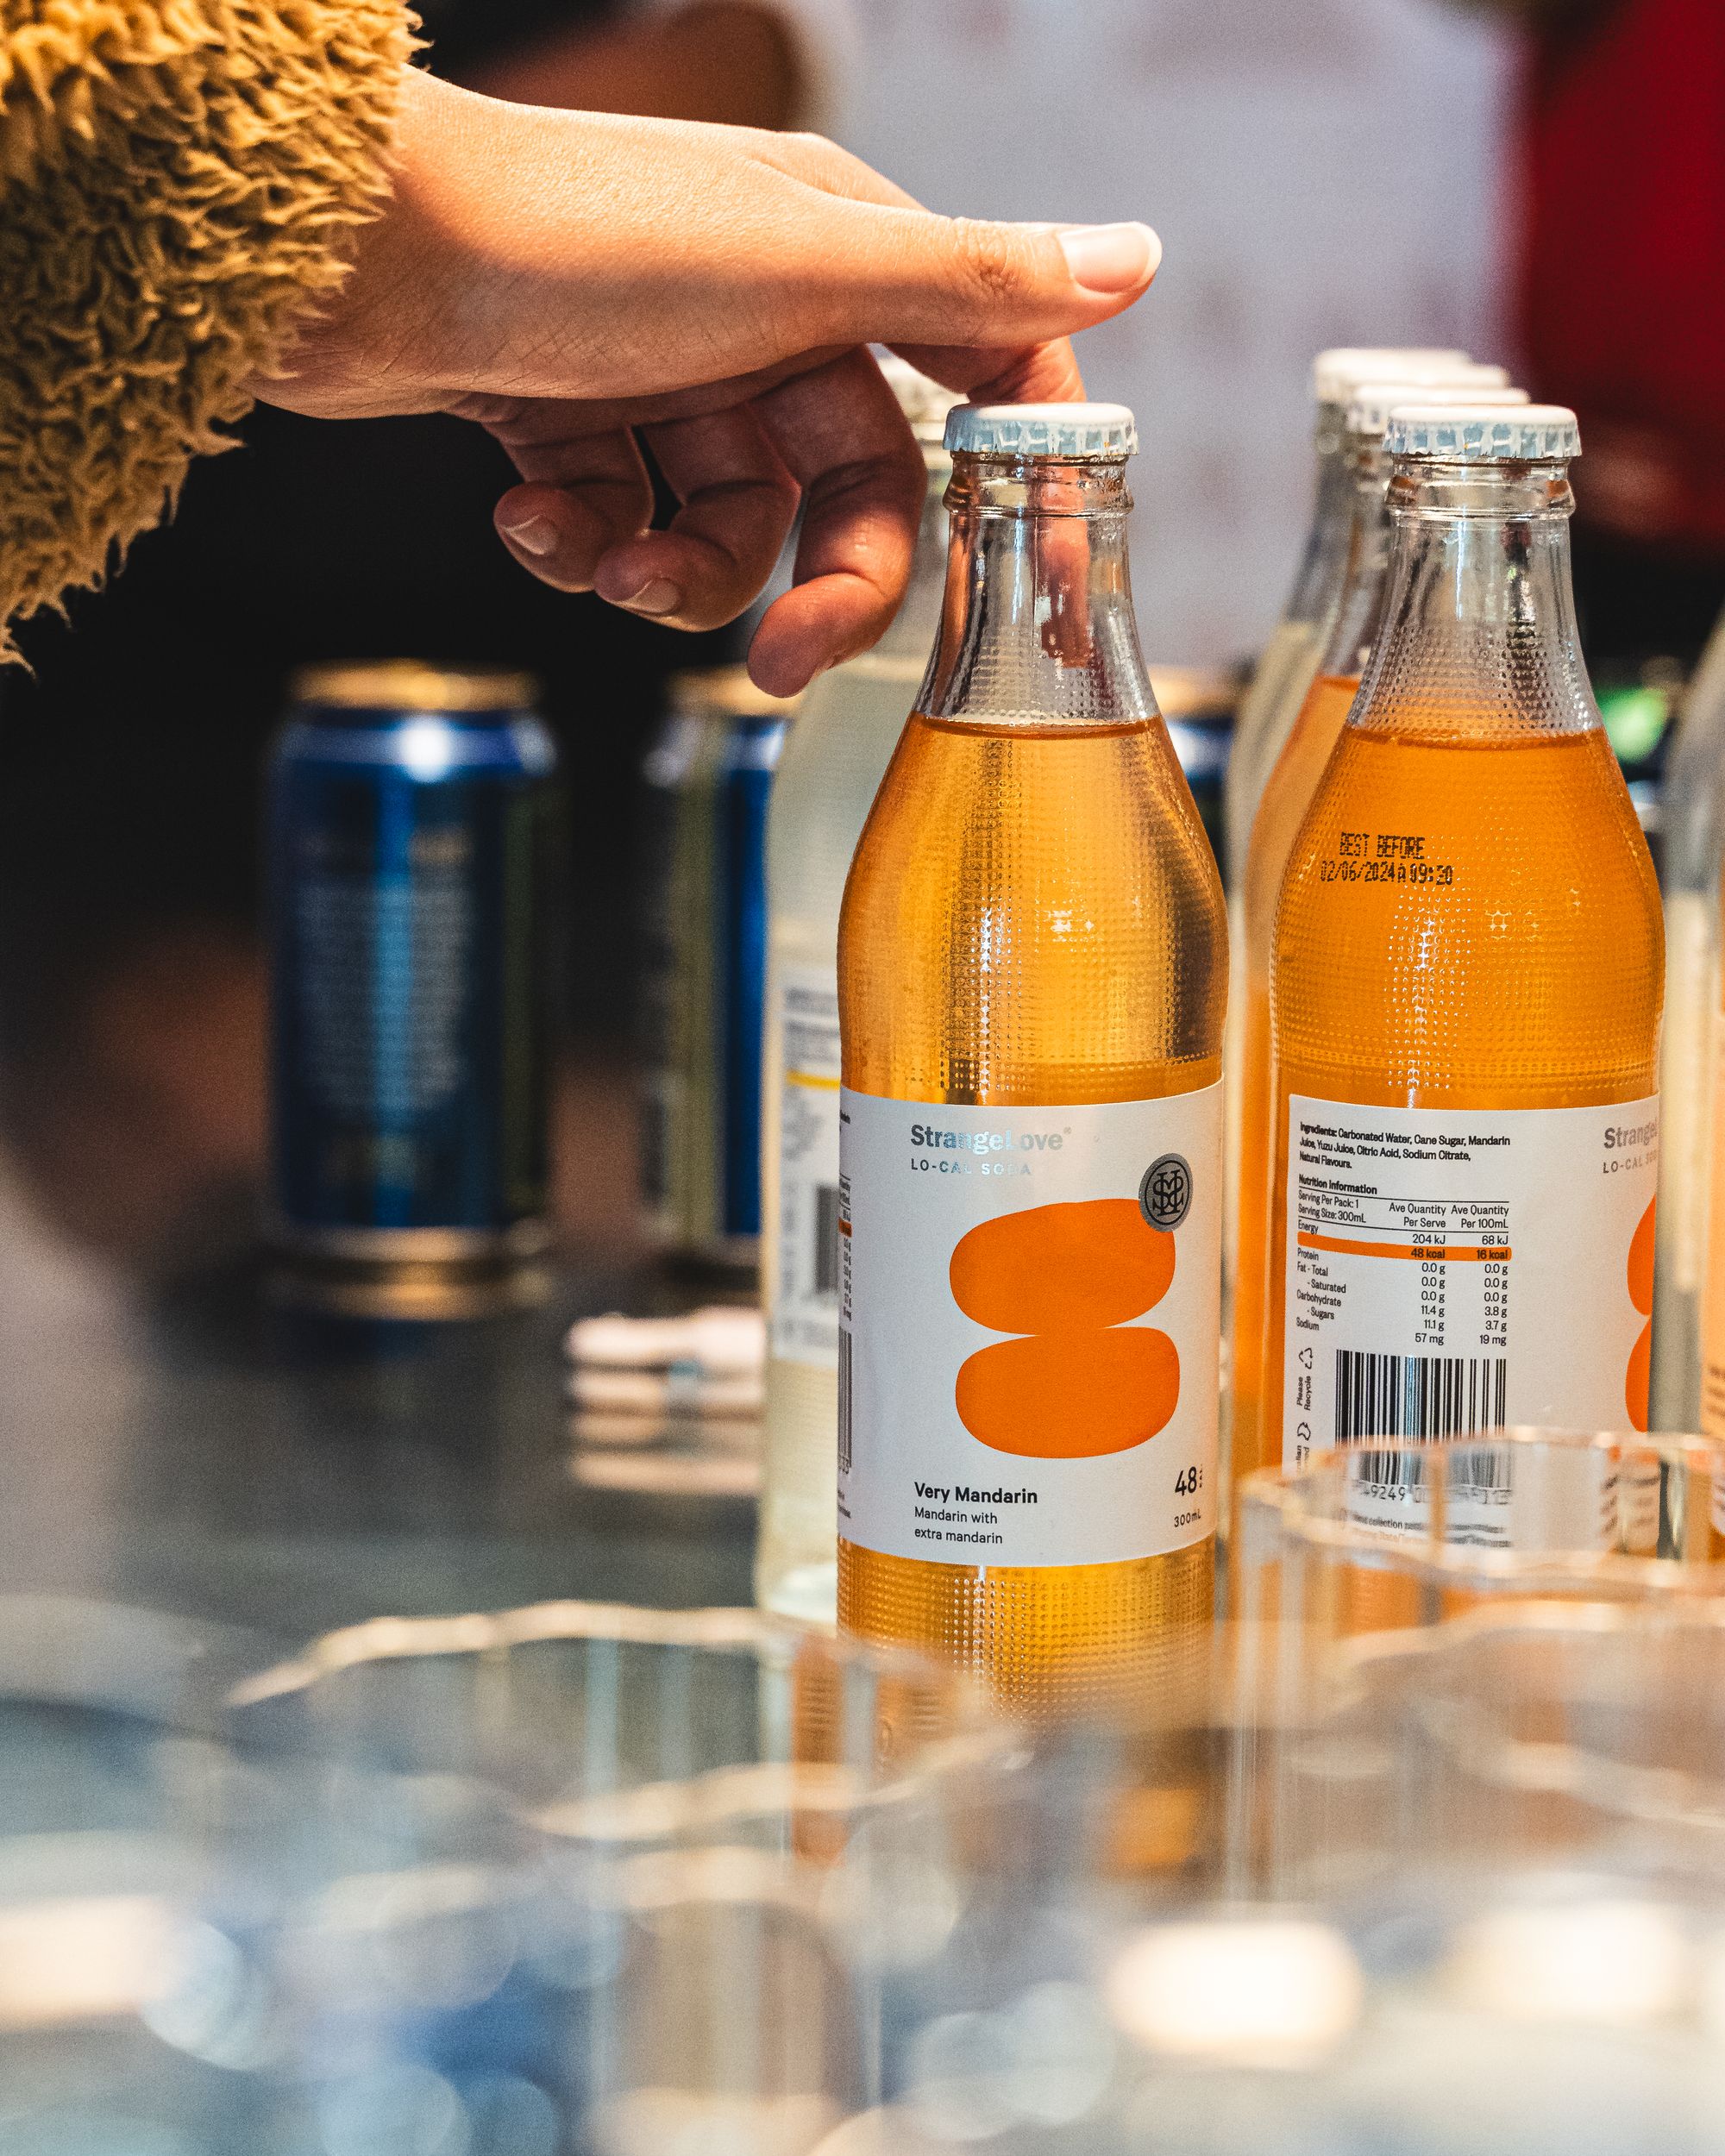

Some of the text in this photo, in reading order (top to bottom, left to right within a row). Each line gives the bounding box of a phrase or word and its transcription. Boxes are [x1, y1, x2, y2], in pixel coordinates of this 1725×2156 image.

[1339, 831, 1425, 859] BEST BEFORE
[1339, 1128, 1383, 1143] Carbonated
[1385, 1132, 1413, 1145] Water,
[1414, 1134, 1437, 1145] Cane
[1439, 1135, 1466, 1147] Sugar,
[1468, 1136, 1510, 1145] Mandarin
[1300, 1138, 1471, 1162] Juice, Yuzu Juice, Citric Acid, Sodium Citrate,
[911, 1158, 972, 1174] LO-CAL
[1299, 1150, 1352, 1169] Natural Flavours.
[1603, 1156, 1642, 1174] LO-CAL
[1299, 1174, 1377, 1194] Nutrition Information
[1299, 1189, 1359, 1209] Serving Per Pack: 1
[1298, 1203, 1366, 1223] Serving Size: 300mL
[1389, 1202, 1446, 1216] Ave Quantity
[1450, 1204, 1509, 1217] Ave Quantity
[1298, 1219, 1319, 1235] Energy
[1403, 1217, 1446, 1228] Per Serve
[1461, 1219, 1509, 1228] Per 100mL
[1412, 1233, 1446, 1244] 204 kJ
[1482, 1235, 1509, 1245] 68 kJ
[1297, 1248, 1320, 1261] Protein
[1411, 1248, 1446, 1259] 48 kcal
[1477, 1250, 1508, 1259] 16 kcal
[1297, 1261, 1306, 1272] Fat
[1311, 1264, 1328, 1277] Total
[1421, 1263, 1446, 1275] 0.0 g
[1484, 1263, 1509, 1275] 0.0 g
[1311, 1279, 1346, 1294] Saturated
[1421, 1276, 1446, 1289] 0.0 g
[1484, 1278, 1508, 1290] 0.0 g
[1296, 1289, 1341, 1307] Carbohydrate
[1421, 1291, 1445, 1304] 0.0 g
[1484, 1292, 1508, 1304] 0.0 g
[1311, 1307, 1334, 1320] Sugars
[1421, 1305, 1445, 1318] 11.4 g
[1484, 1307, 1508, 1319] 3.8 g
[1296, 1317, 1320, 1331] Sodium
[1424, 1319, 1445, 1332] 11.1 g
[1485, 1320, 1507, 1332] 3.7 g
[1414, 1333, 1445, 1346] 57 mg
[1480, 1334, 1507, 1346] 19 mg
[1175, 1466, 1197, 1496] 48
[914, 1482, 1038, 1504] Very Mandarin
[914, 1506, 998, 1524] Mandarin with
[1174, 1508, 1201, 1528] 300mL
[914, 1527, 1003, 1545] extra mandarin
